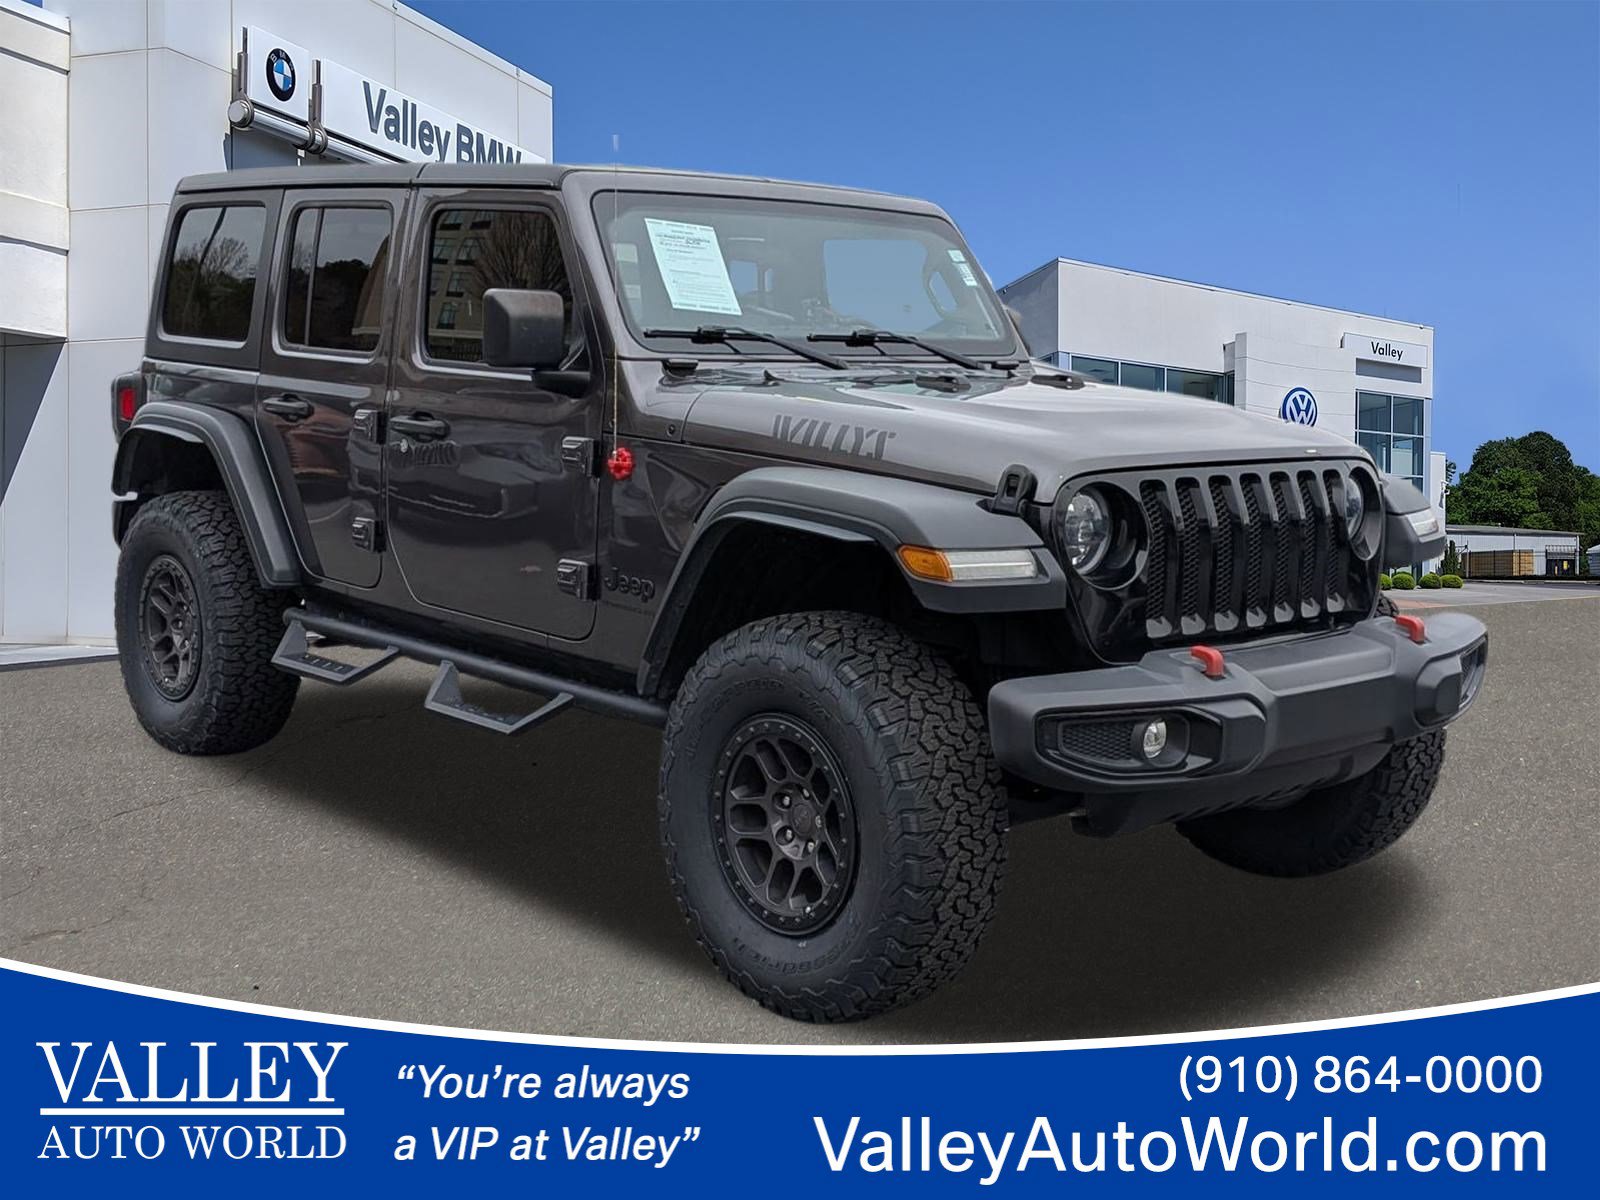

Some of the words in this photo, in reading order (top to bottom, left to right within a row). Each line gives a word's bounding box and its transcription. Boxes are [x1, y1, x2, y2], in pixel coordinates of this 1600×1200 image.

[362, 80, 451, 163] Valley
[1371, 341, 1403, 361] Valley
[603, 567, 655, 603] Jeep
